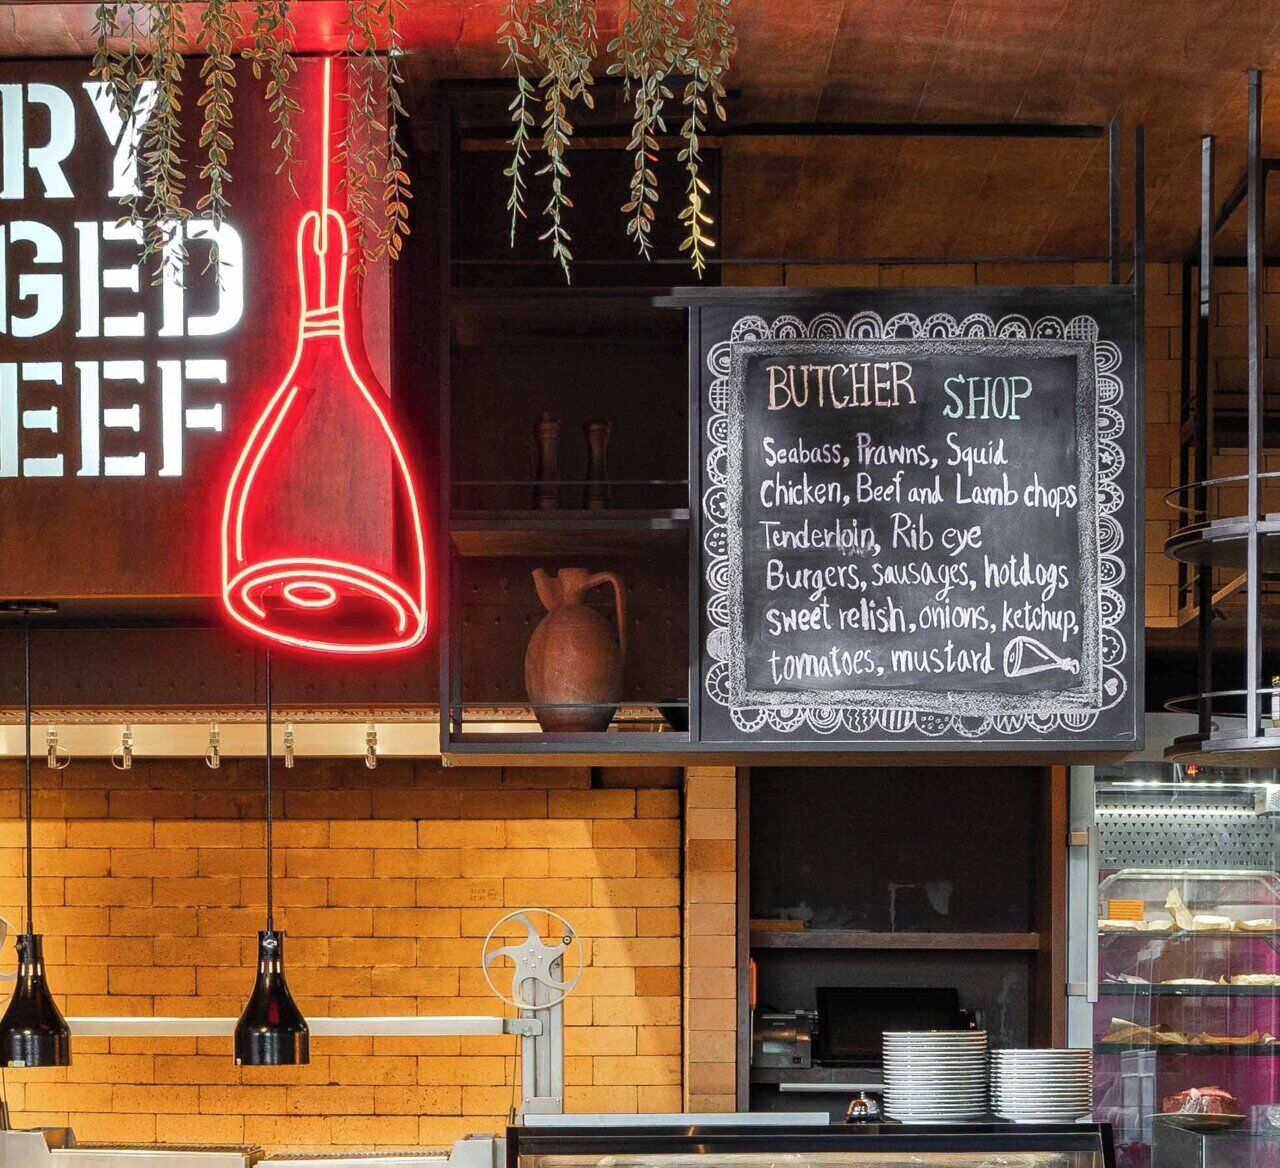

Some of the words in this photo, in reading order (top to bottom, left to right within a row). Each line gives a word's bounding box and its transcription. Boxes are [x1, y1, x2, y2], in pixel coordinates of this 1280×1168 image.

[765, 361, 917, 411] BUTCHER
[942, 374, 1033, 420] SHOP
[762, 436, 850, 468] Seabass,
[855, 432, 940, 468] Prawns,
[946, 432, 1009, 475] Squid
[760, 473, 851, 508] Chicken,
[856, 471, 905, 503] Beef
[907, 480, 943, 503] and
[956, 473, 1019, 508] Lamb
[1023, 472, 1077, 516] chops
[759, 520, 882, 556] Tenderloin,
[890, 512, 933, 551] Rib
[941, 524, 982, 556] eye
[766, 560, 867, 601] Burgers,
[871, 560, 977, 601] sausages,
[984, 554, 1069, 600] hotdogs
[766, 601, 830, 637] sweet
[839, 597, 916, 634] relish,
[919, 603, 996, 634] onions,
[1002, 600, 1079, 643] ketchup,
[766, 648, 885, 685] tomatoes,
[890, 641, 995, 675] mustard
